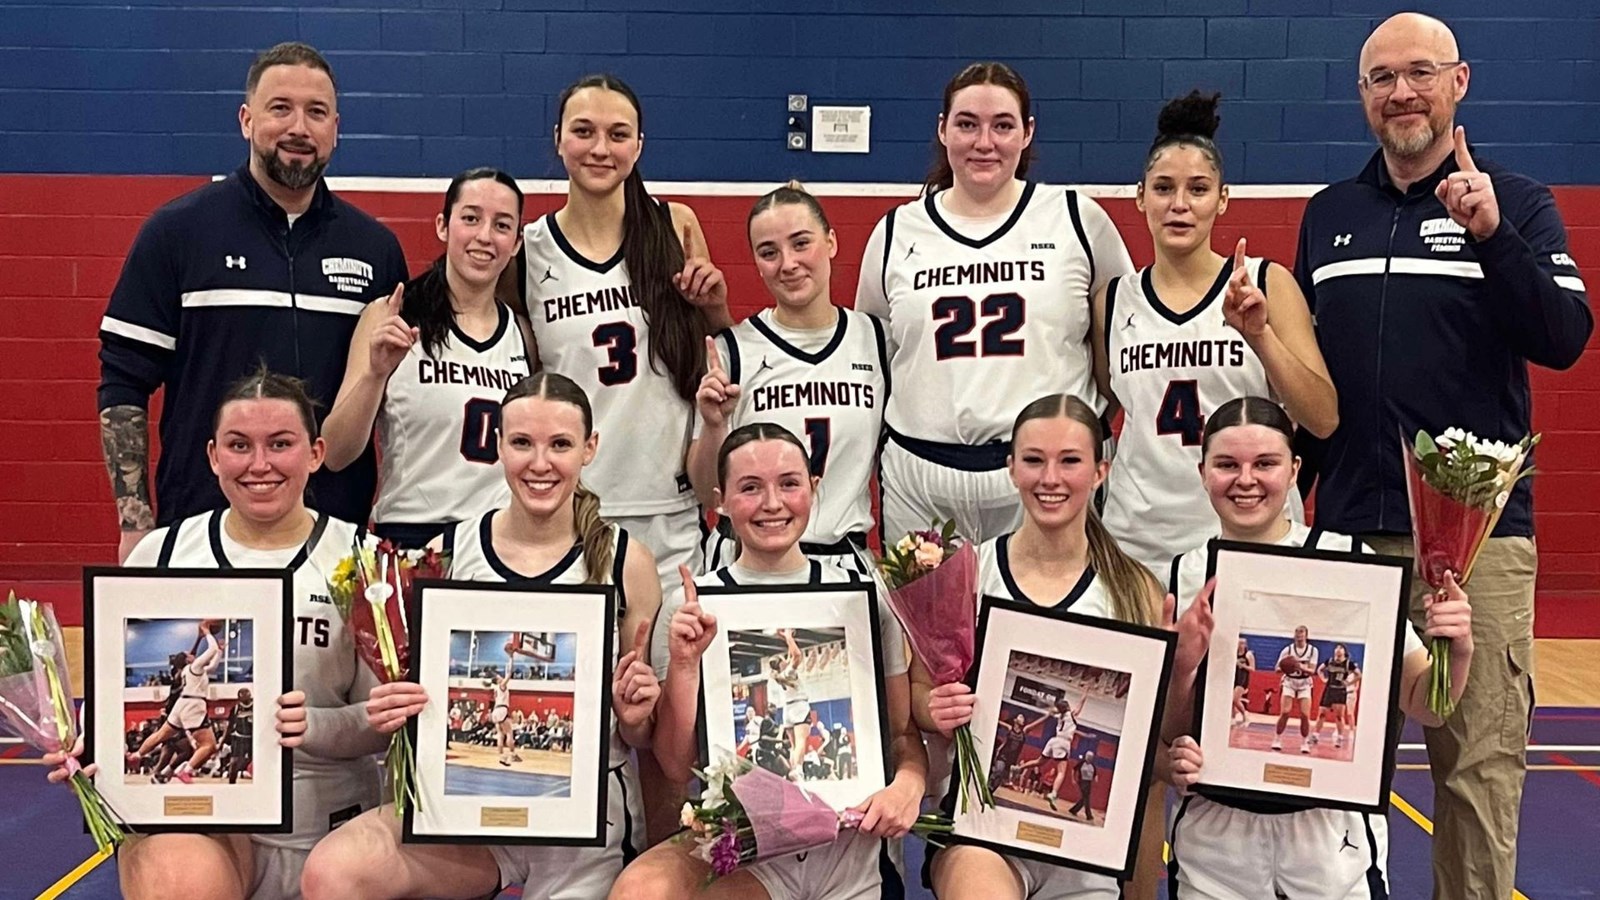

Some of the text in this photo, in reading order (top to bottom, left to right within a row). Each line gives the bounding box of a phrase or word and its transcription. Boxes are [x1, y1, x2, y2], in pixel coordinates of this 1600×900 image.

[914, 261, 1046, 290] CHEMINOTS
[932, 292, 1026, 361] 22
[419, 360, 525, 391] CHEMINOT
[592, 321, 638, 387] 3
[1120, 340, 1244, 374] CHEMINOTS
[753, 381, 875, 412] CHEMINOTS
[1156, 379, 1206, 447] 4
[460, 397, 502, 465] 0
[804, 416, 831, 478] 1
[310, 594, 332, 604] RSE
